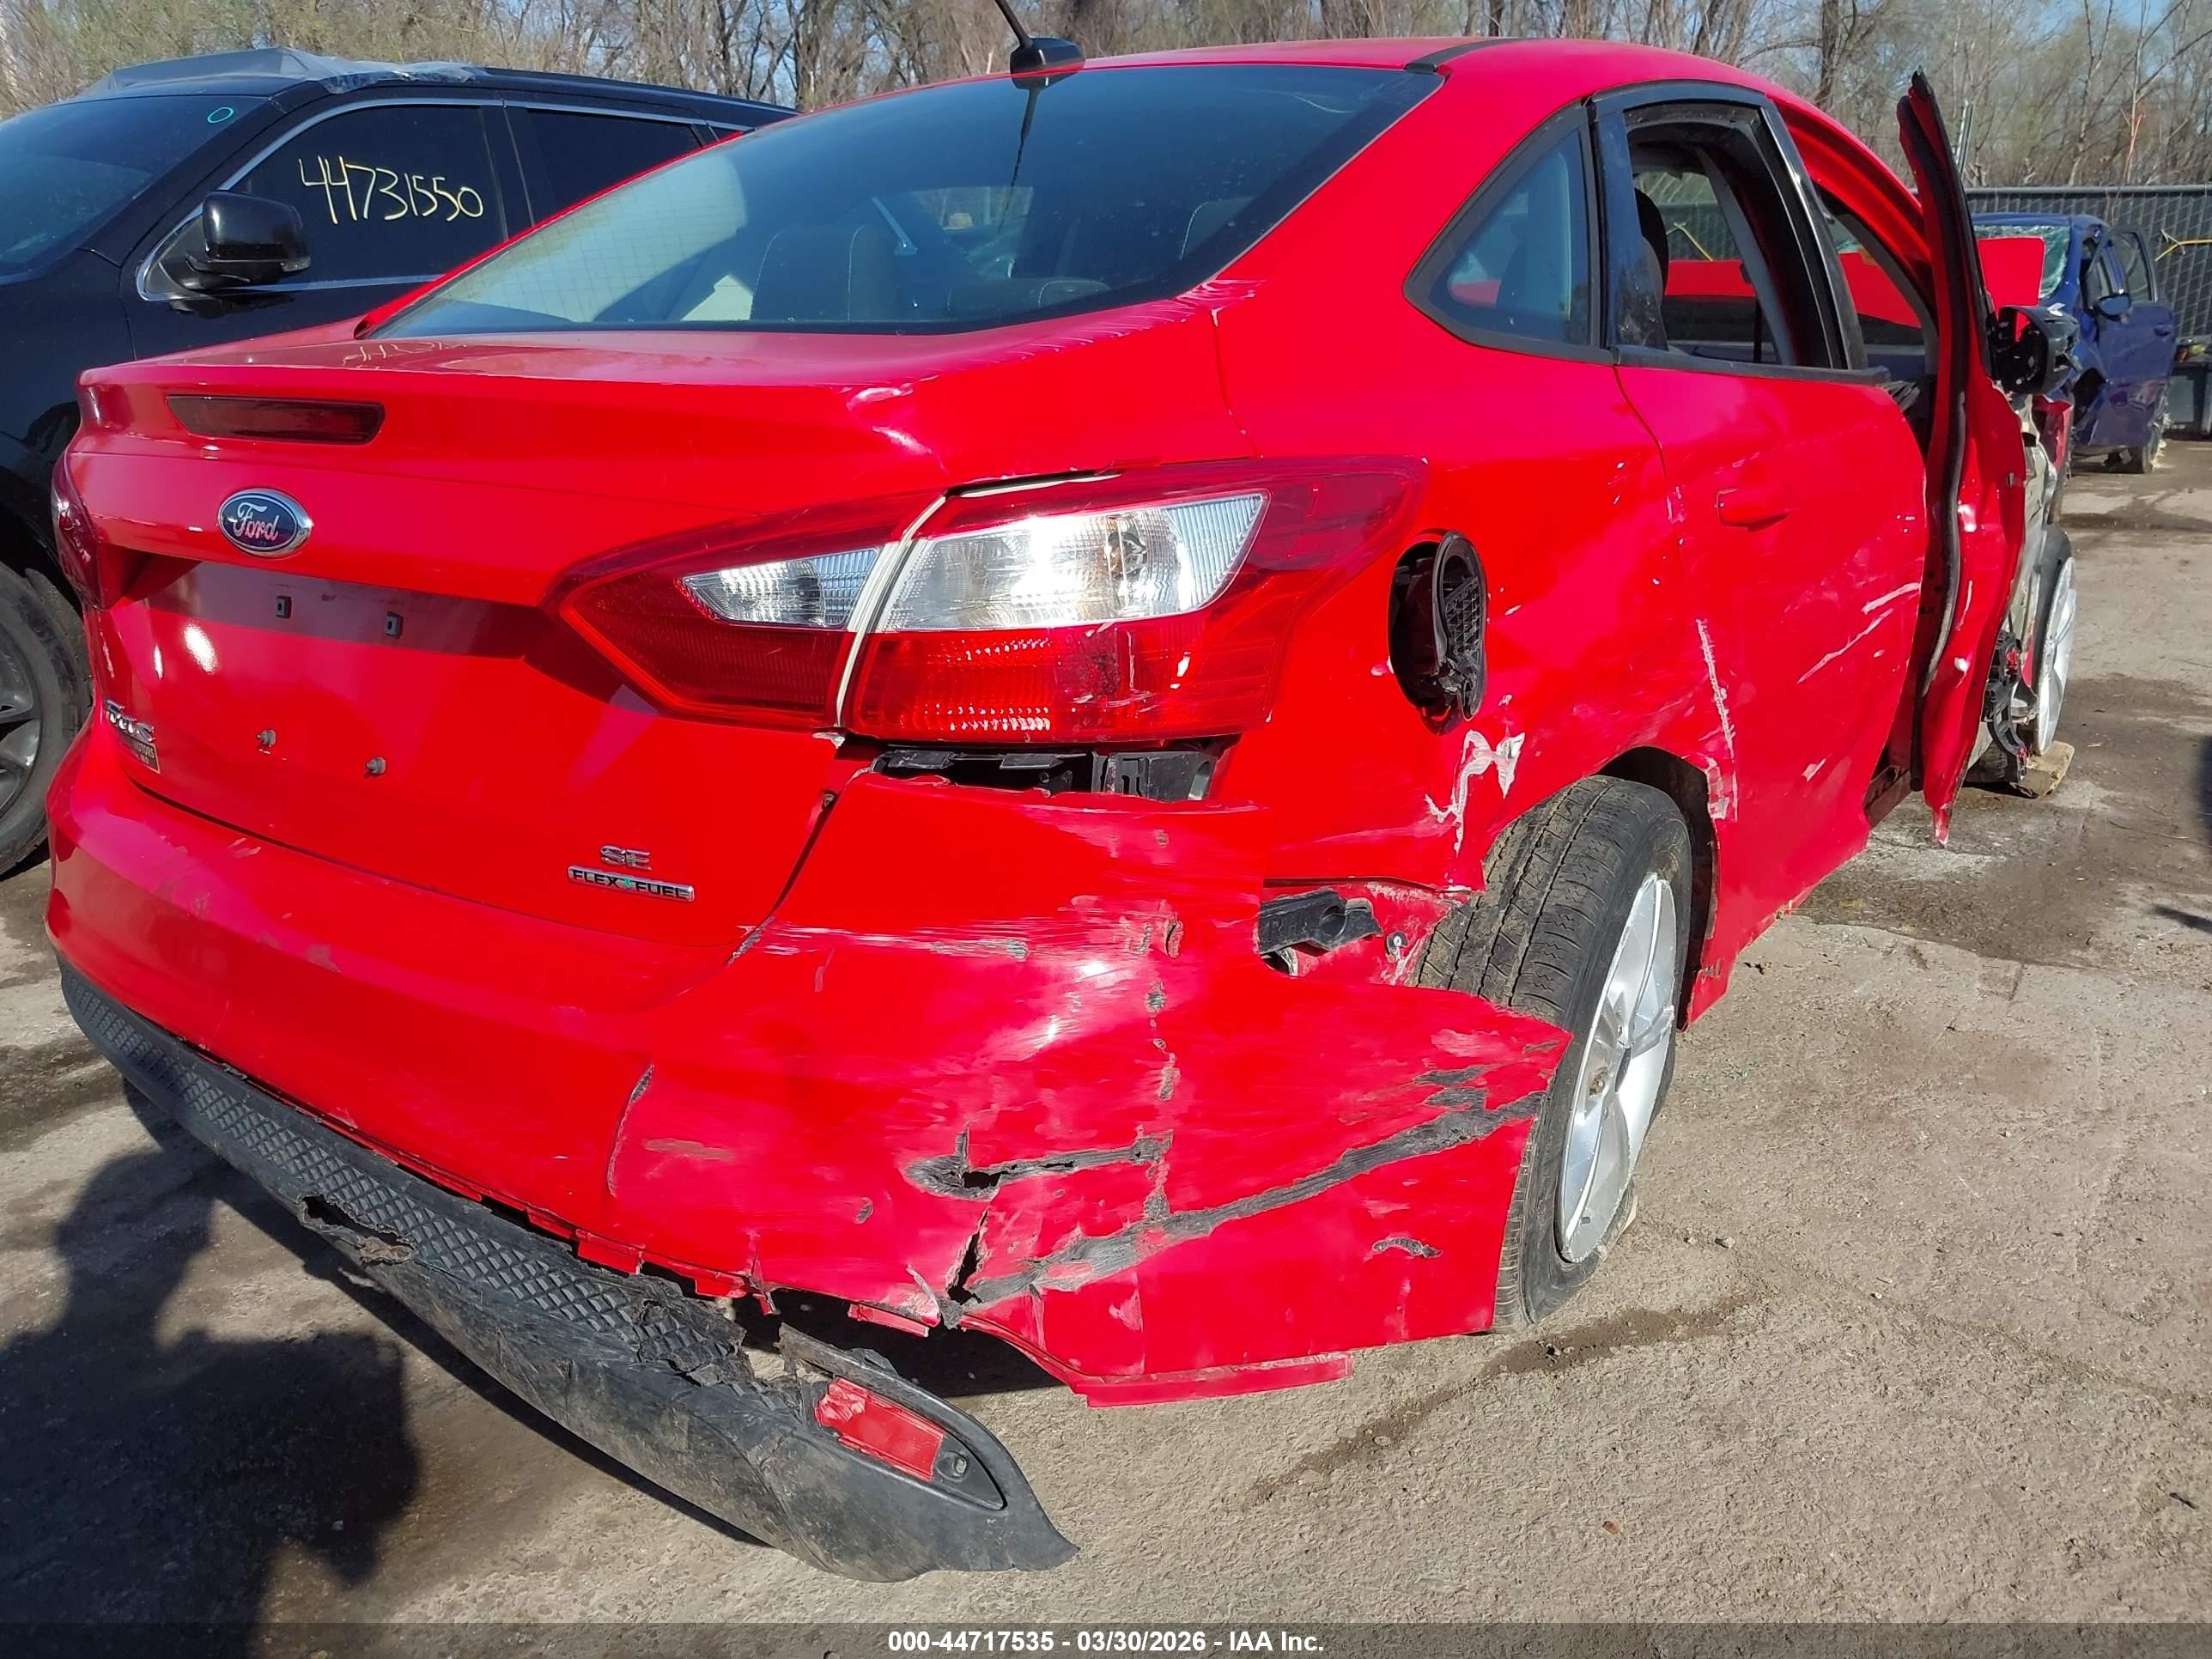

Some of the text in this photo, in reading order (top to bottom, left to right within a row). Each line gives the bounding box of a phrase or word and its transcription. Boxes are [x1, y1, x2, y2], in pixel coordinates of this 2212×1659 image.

[298, 155, 484, 225] 44731550
[232, 501, 280, 541] Ford
[600, 845, 652, 871] SE
[571, 868, 690, 900] FLEX FUEL
